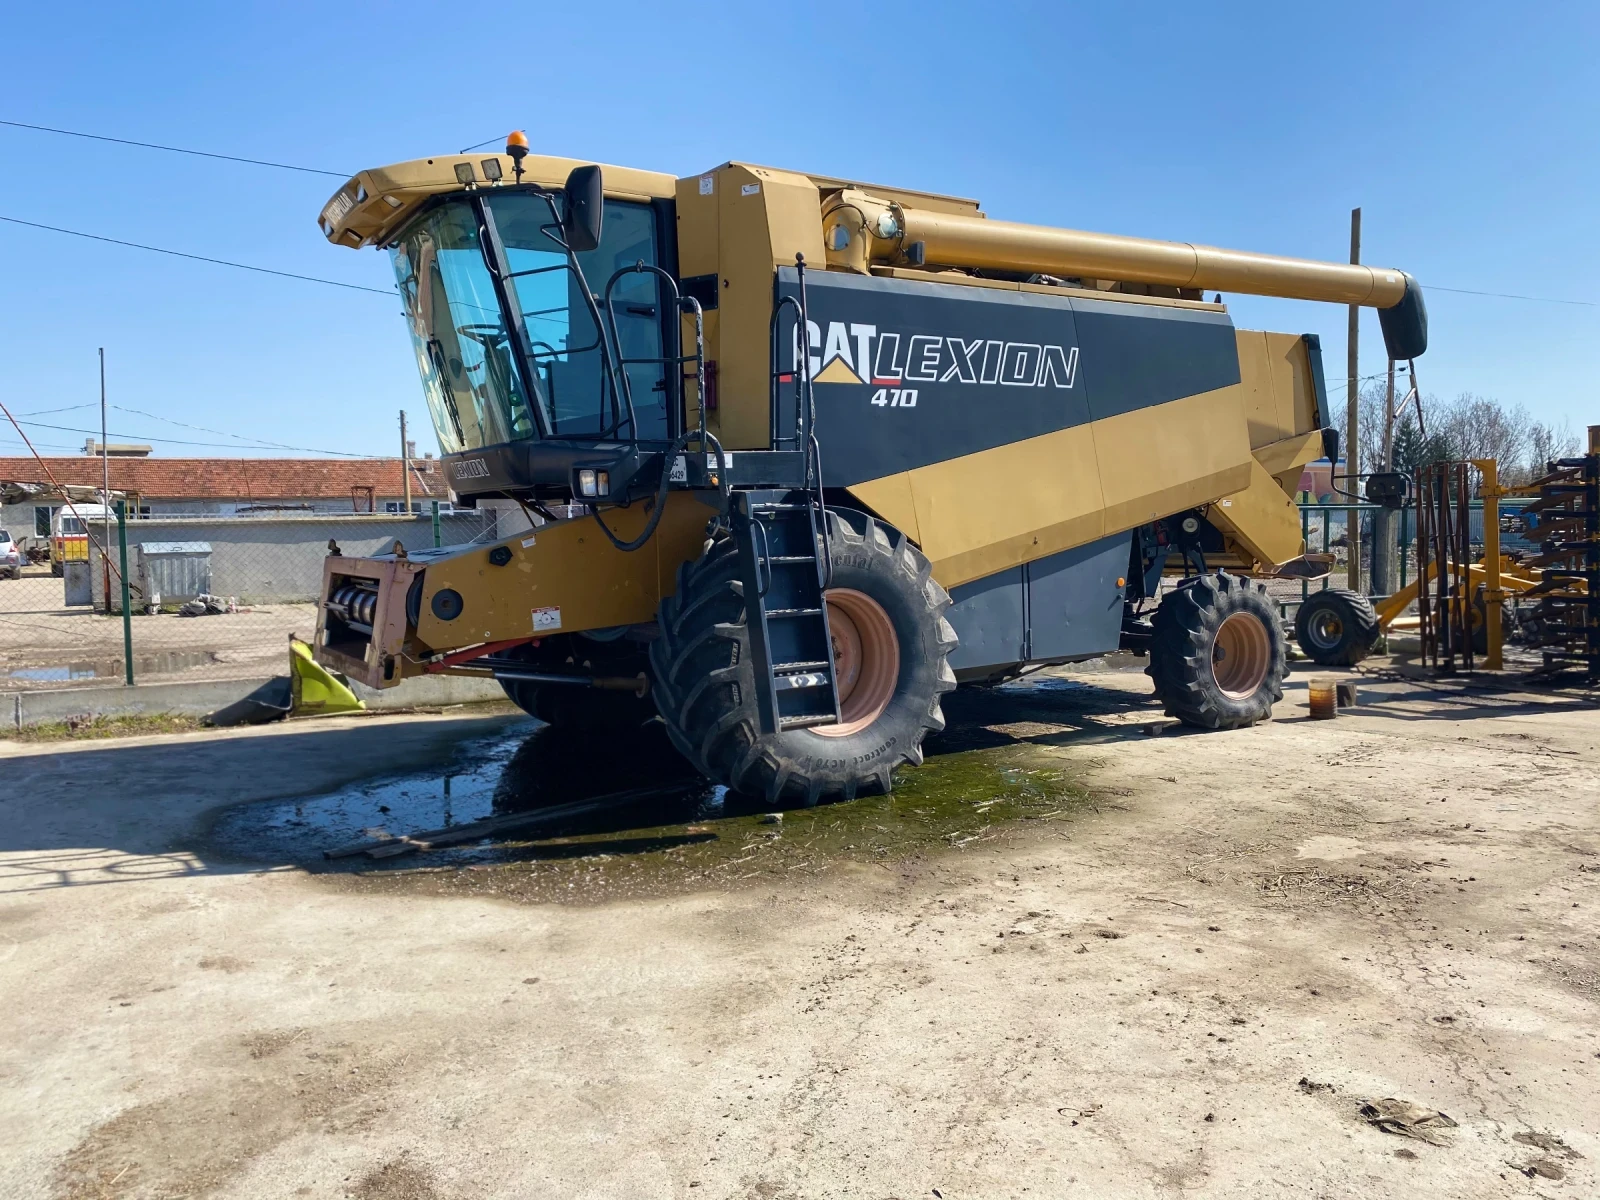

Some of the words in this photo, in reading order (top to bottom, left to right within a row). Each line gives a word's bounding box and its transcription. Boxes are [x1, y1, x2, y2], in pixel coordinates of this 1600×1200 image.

[793, 319, 876, 385] CAT
[873, 332, 1079, 389] LEXION
[870, 388, 919, 407] 470
